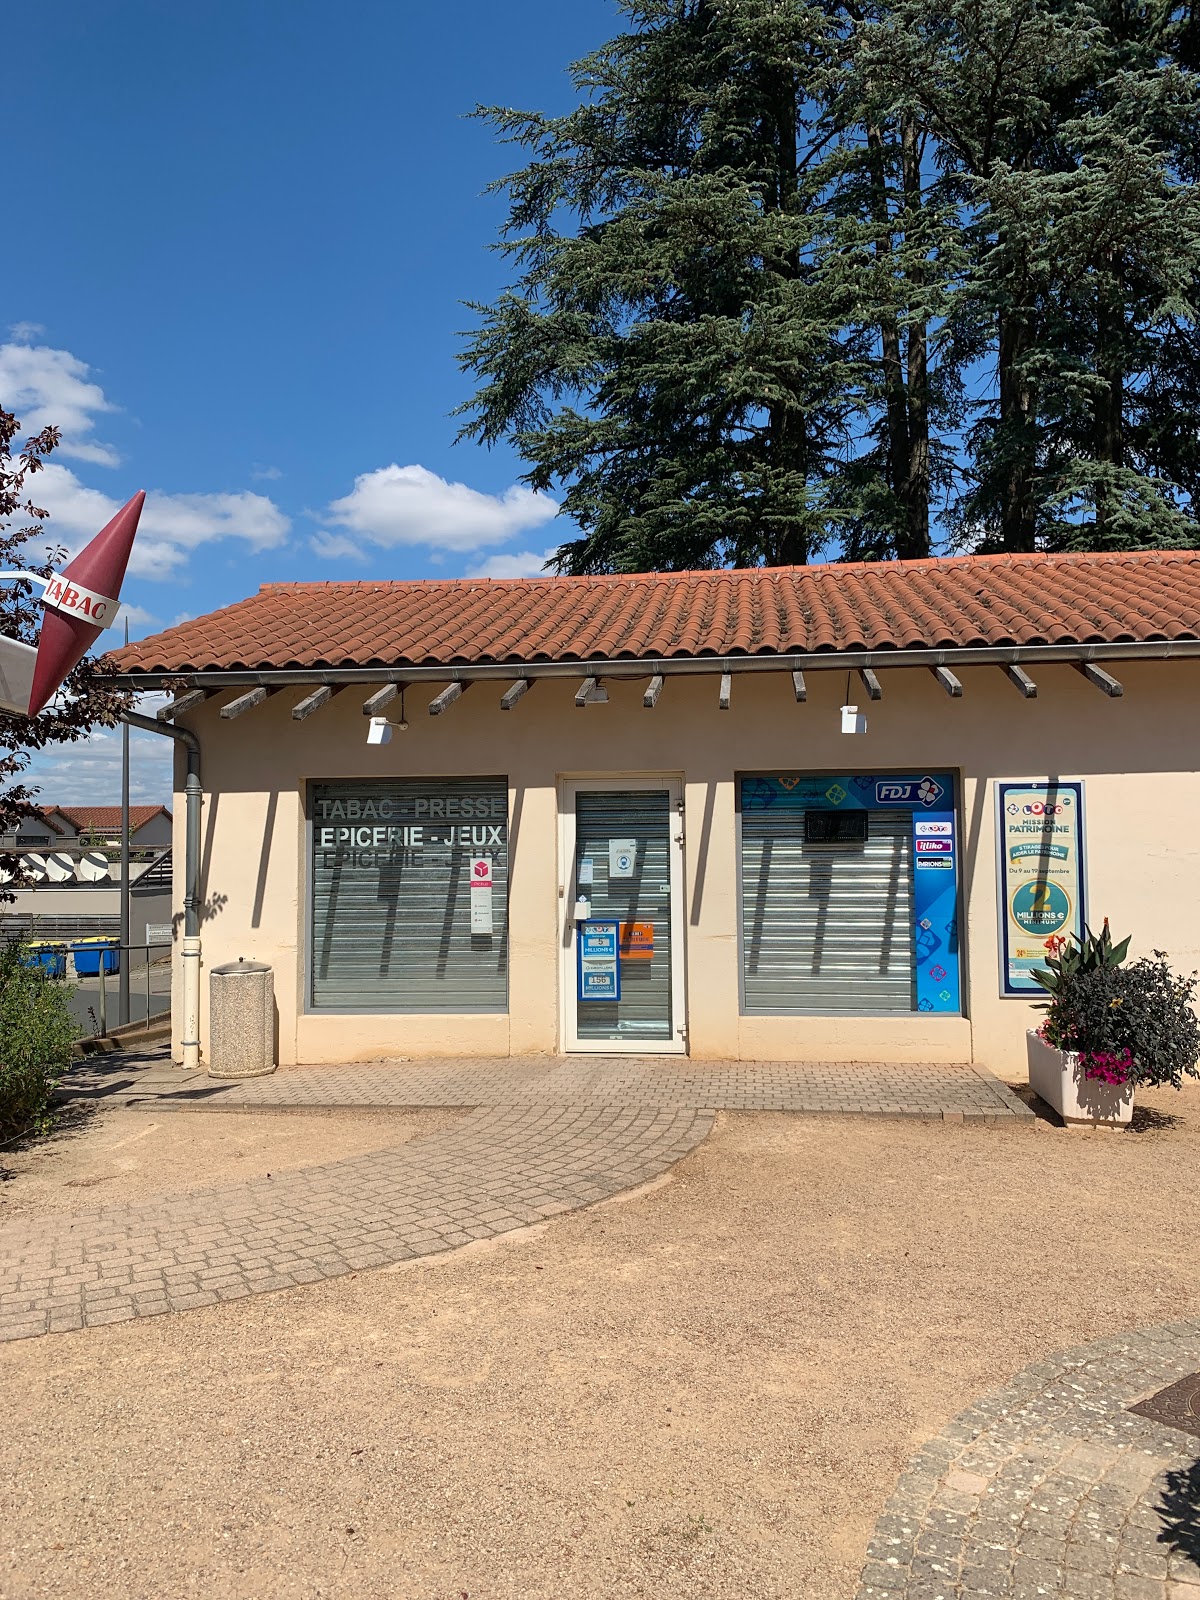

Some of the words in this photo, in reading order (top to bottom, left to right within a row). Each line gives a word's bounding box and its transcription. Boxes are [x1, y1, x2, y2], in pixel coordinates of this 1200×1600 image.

[45, 578, 107, 620] TABAC
[880, 785, 912, 799] FDJ
[317, 799, 393, 820] TABAC
[414, 798, 505, 818] PRESSE
[1022, 801, 1063, 815] LOTO
[320, 826, 424, 847] EPICERIE
[443, 825, 503, 846] JEUX
[1009, 825, 1070, 833] PATRIMOINE
[1034, 850, 1065, 858] PATRIMOINE
[1029, 883, 1051, 911] 2
[591, 976, 607, 984] 156
